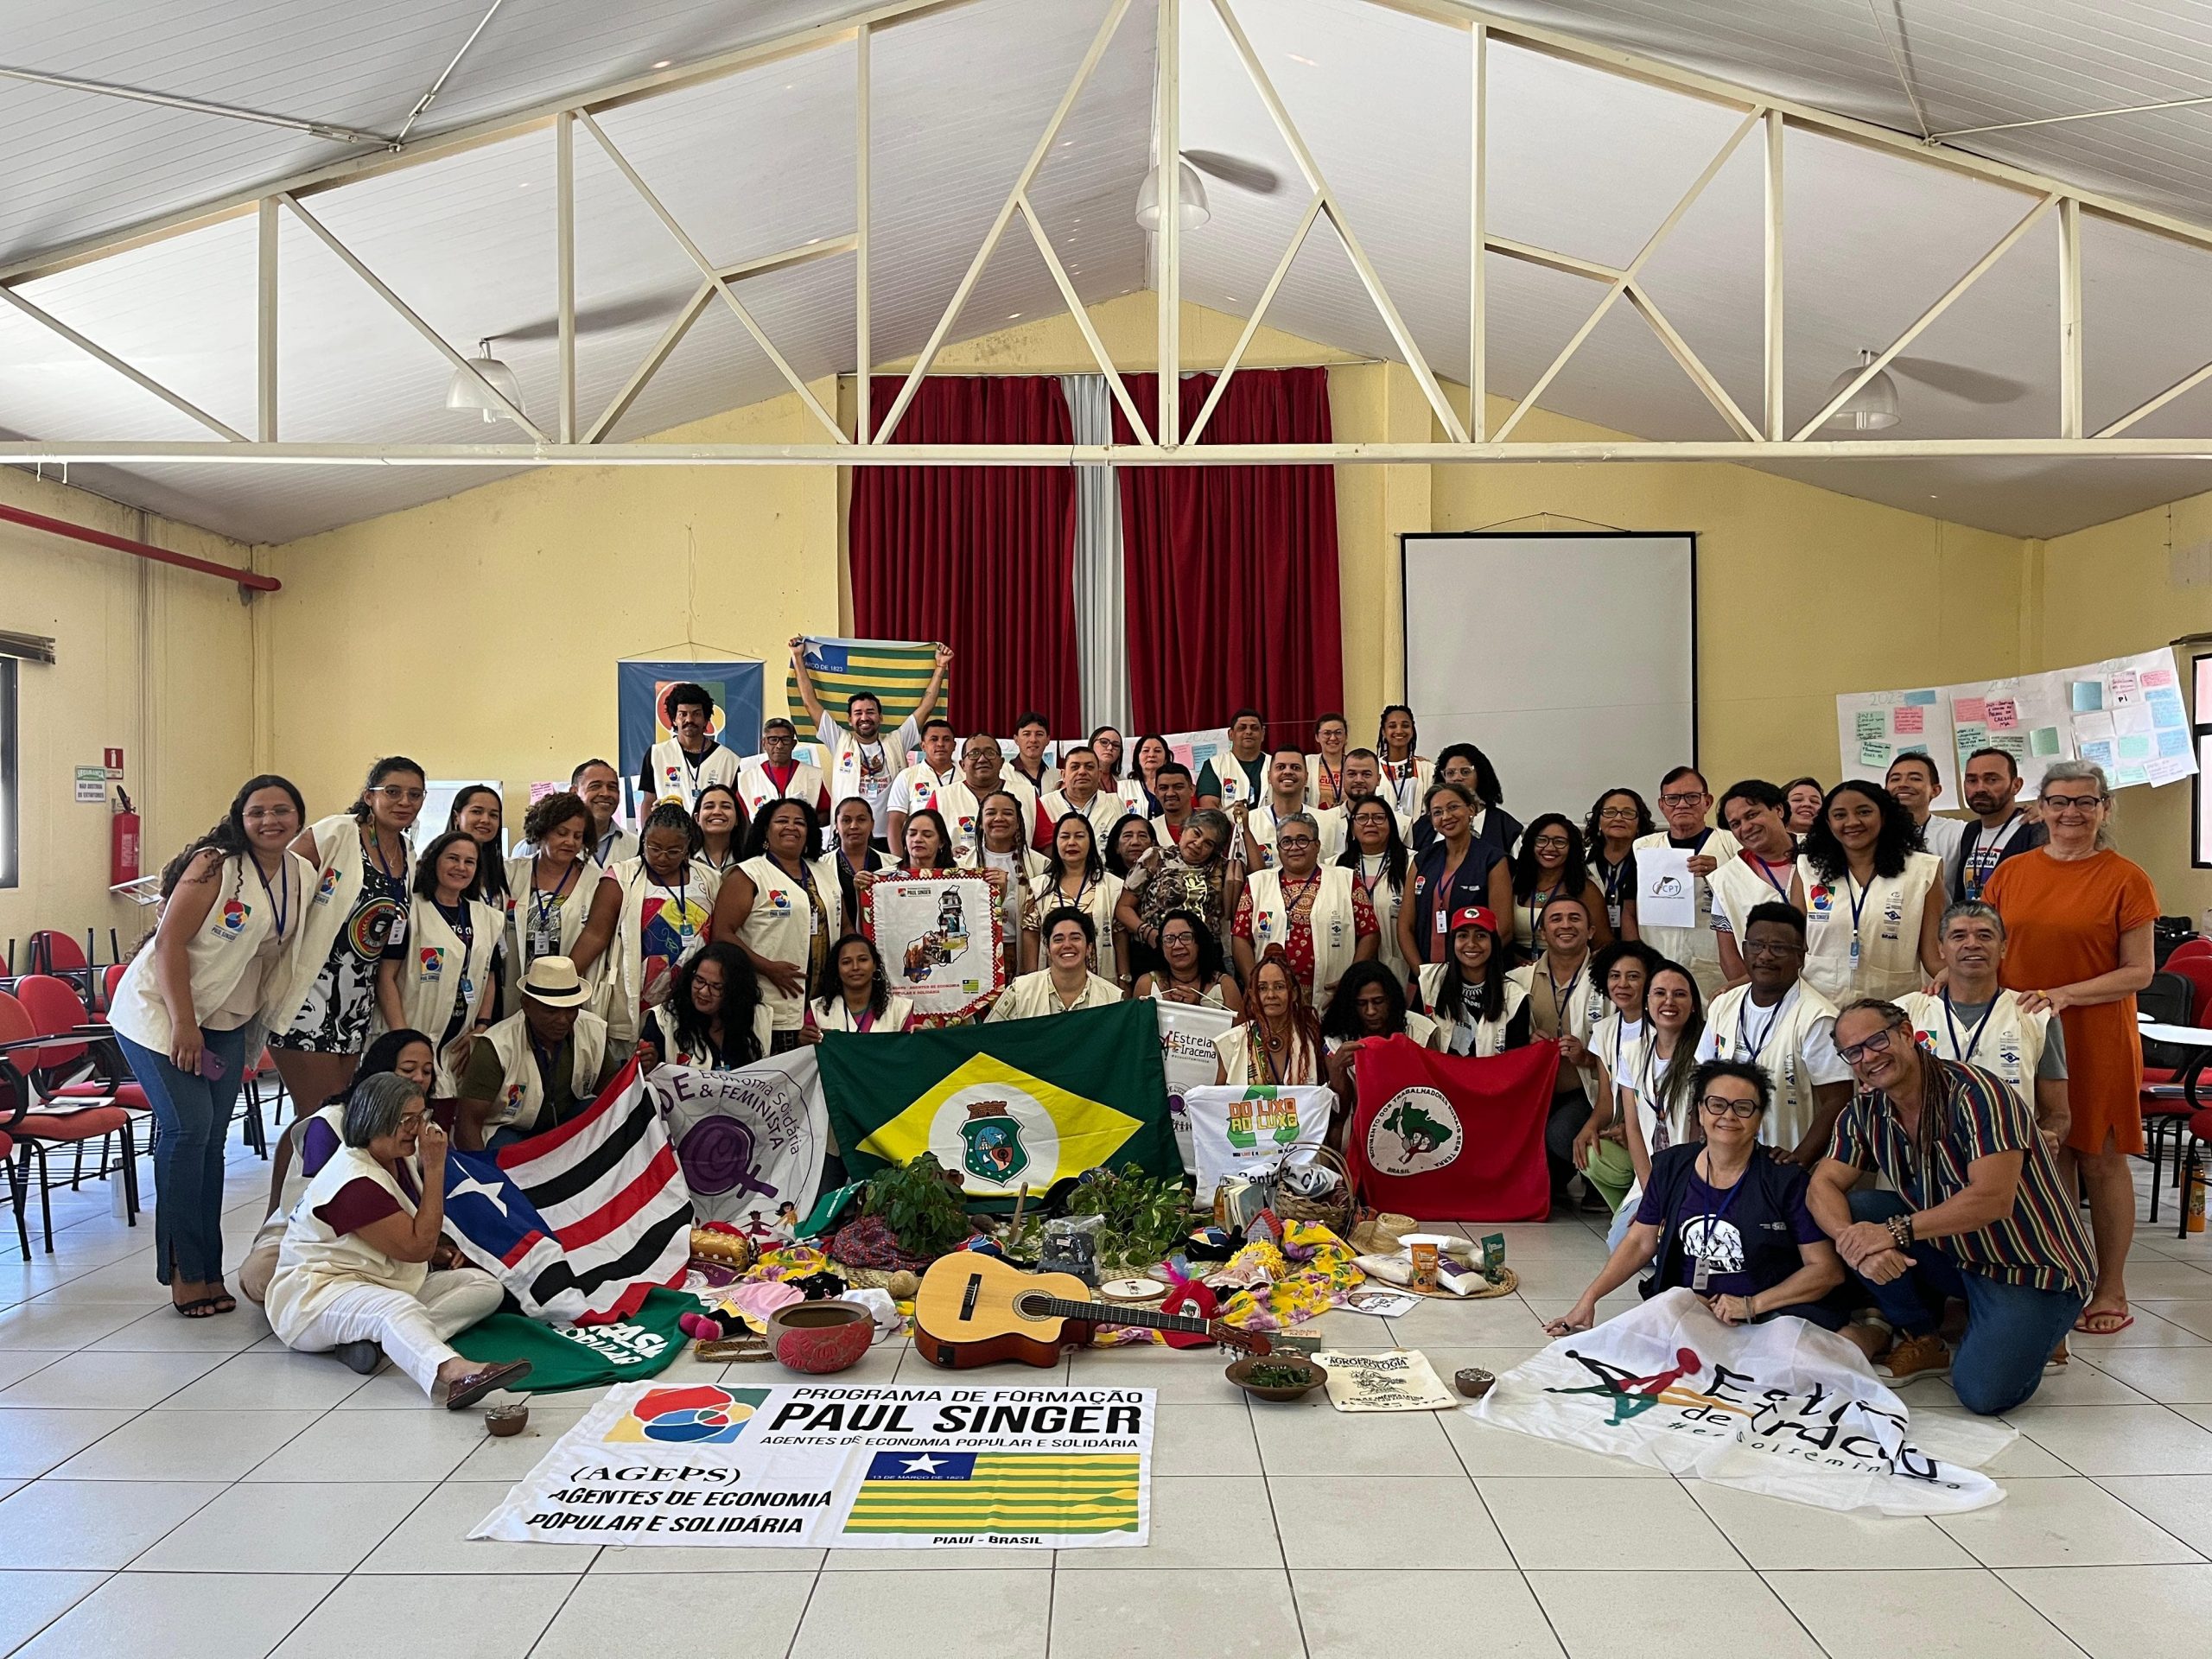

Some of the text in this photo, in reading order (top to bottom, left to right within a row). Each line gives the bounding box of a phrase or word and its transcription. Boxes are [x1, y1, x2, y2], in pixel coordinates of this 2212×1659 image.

[1662, 885, 1679, 893] CPT
[1173, 1032, 1213, 1049] Estrela
[1181, 1045, 1217, 1059] Iracema
[1392, 1088, 1449, 1106] TRABALHADORES
[1229, 1097, 1297, 1118] DO LIXO
[1379, 1103, 1392, 1117] DOS
[699, 1084, 714, 1098] &
[719, 1084, 785, 1151] FEMINISTA
[1231, 1114, 1299, 1133] AO LUXO
[1447, 1104, 1461, 1134] RURAIS
[1433, 1153, 1457, 1167] TERRA
[791, 1388, 1143, 1405] PROGRAMA DE FORMAÇÃO
[767, 1402, 1141, 1434] PAUL SINGER
[1681, 1405, 1732, 1427] de
[760, 1435, 1138, 1448] AGENTES DE ECONOMIA POPULAR E SOLIDÁRIA
[570, 1465, 741, 1487] (AGEPS)
[548, 1487, 832, 1507] AGENTES DE ECONOMIA
[525, 1512, 804, 1533] POPULAR E SOLIDÁRIA
[933, 1535, 975, 1544] PIAUÍ
[988, 1535, 1044, 1545] BRASIL
